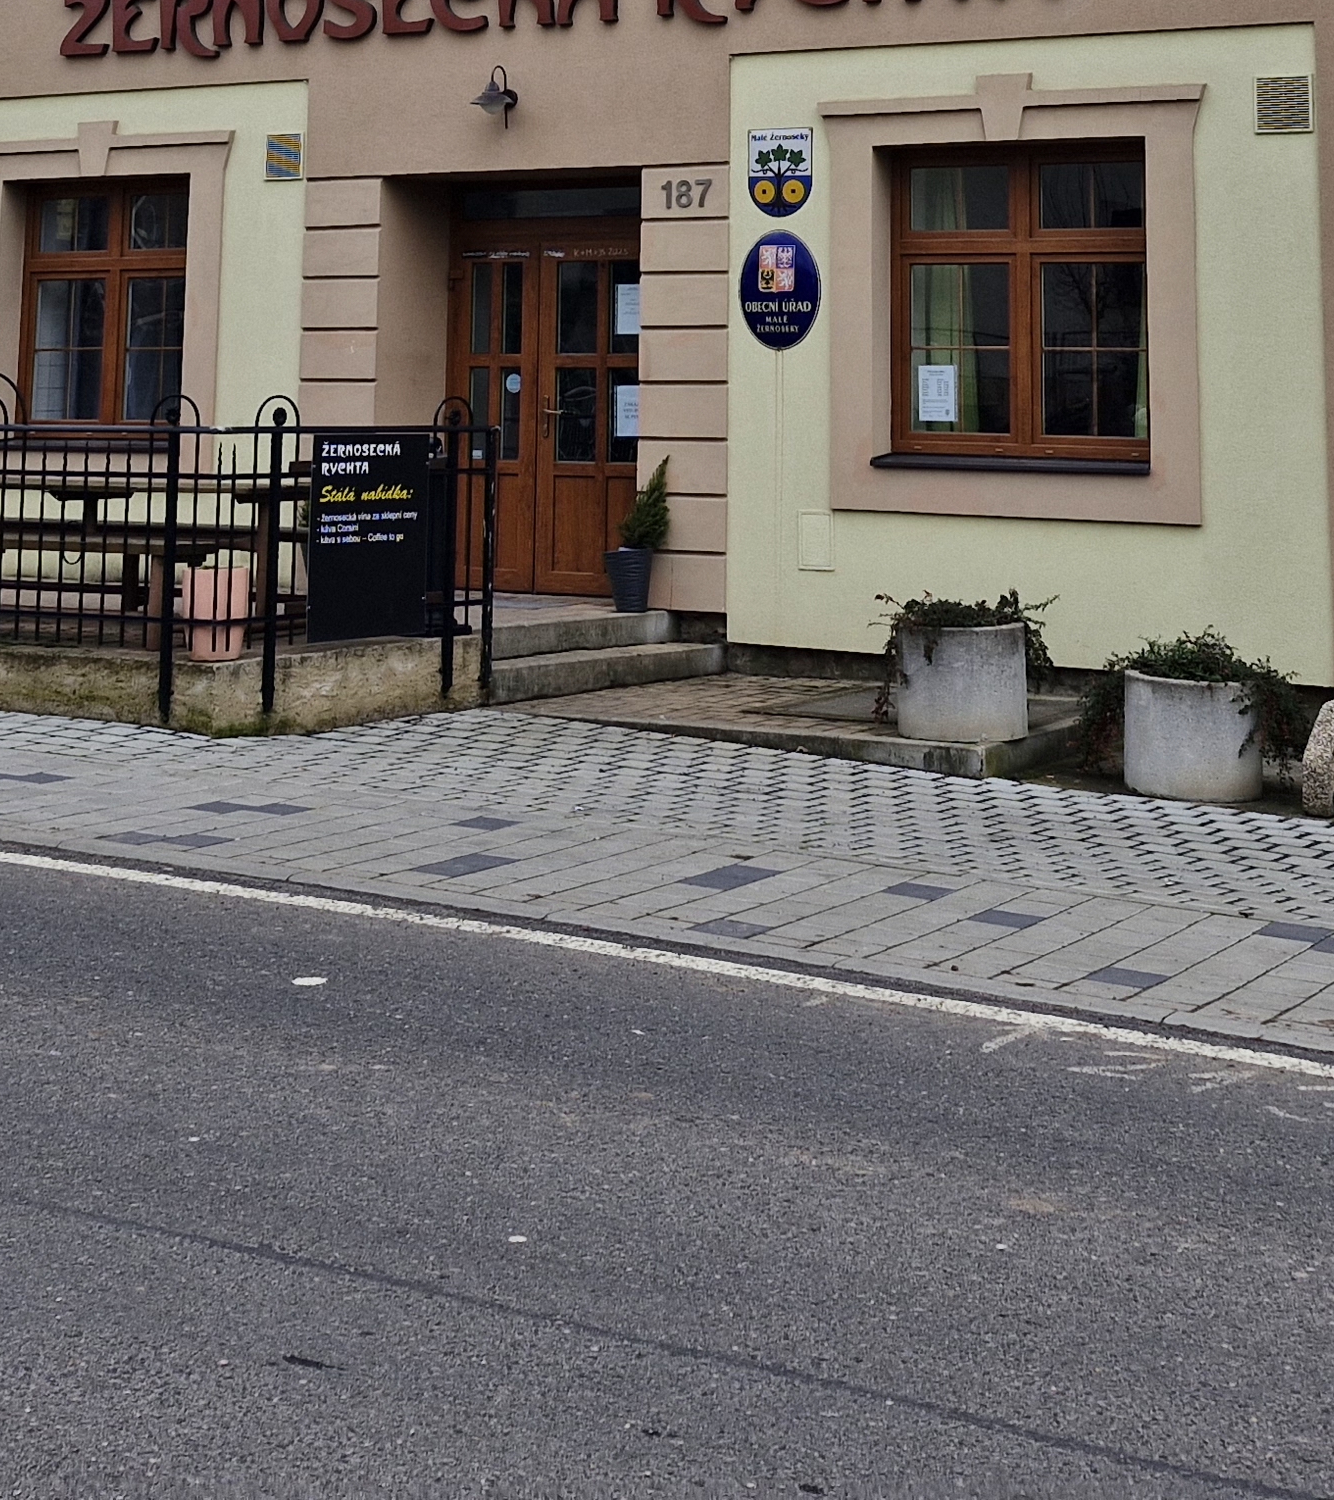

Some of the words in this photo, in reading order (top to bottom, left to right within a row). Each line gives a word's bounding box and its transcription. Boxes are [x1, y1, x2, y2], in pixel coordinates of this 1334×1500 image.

[751, 134, 767, 142] Malé
[661, 179, 713, 209] 187
[745, 298, 778, 312] OBECNÍ
[782, 298, 812, 312] ÚŘAD
[766, 315, 788, 323] MALÉ
[321, 441, 401, 458] ŽERNOSECKÁ
[321, 462, 369, 476] RYCHTA
[320, 485, 355, 503] Stálá
[361, 483, 414, 500] nabídka:
[368, 533, 387, 542] Coffee
[388, 533, 395, 541] to
[396, 534, 404, 543] go
